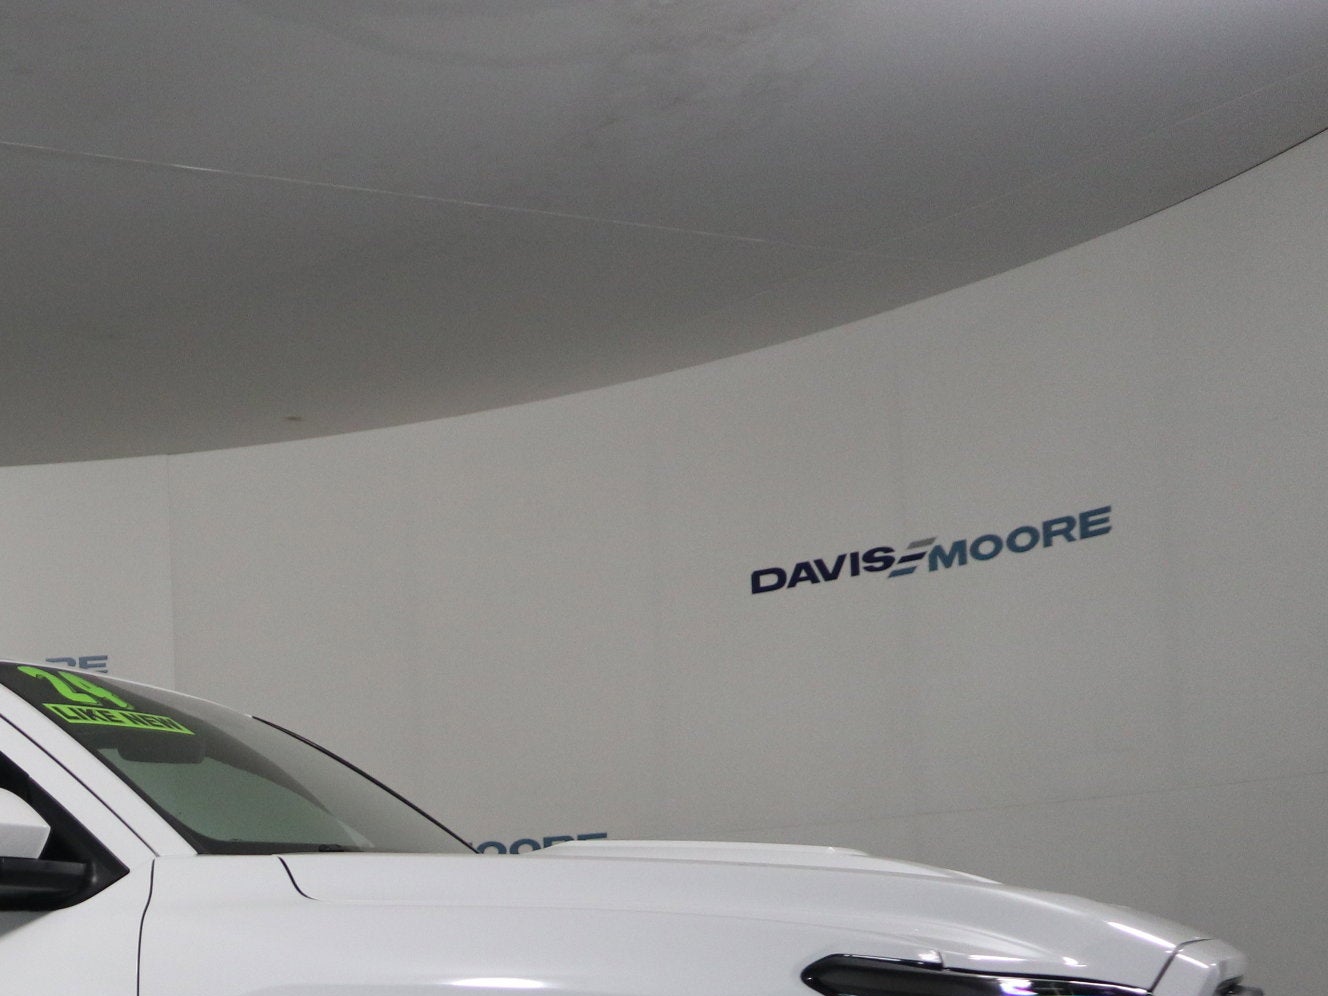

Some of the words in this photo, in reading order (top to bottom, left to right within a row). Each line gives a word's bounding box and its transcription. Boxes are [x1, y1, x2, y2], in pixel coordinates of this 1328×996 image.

[750, 546, 896, 595] DAVIS
[928, 505, 1112, 572] MOORE
[52, 706, 122, 722] LIKE
